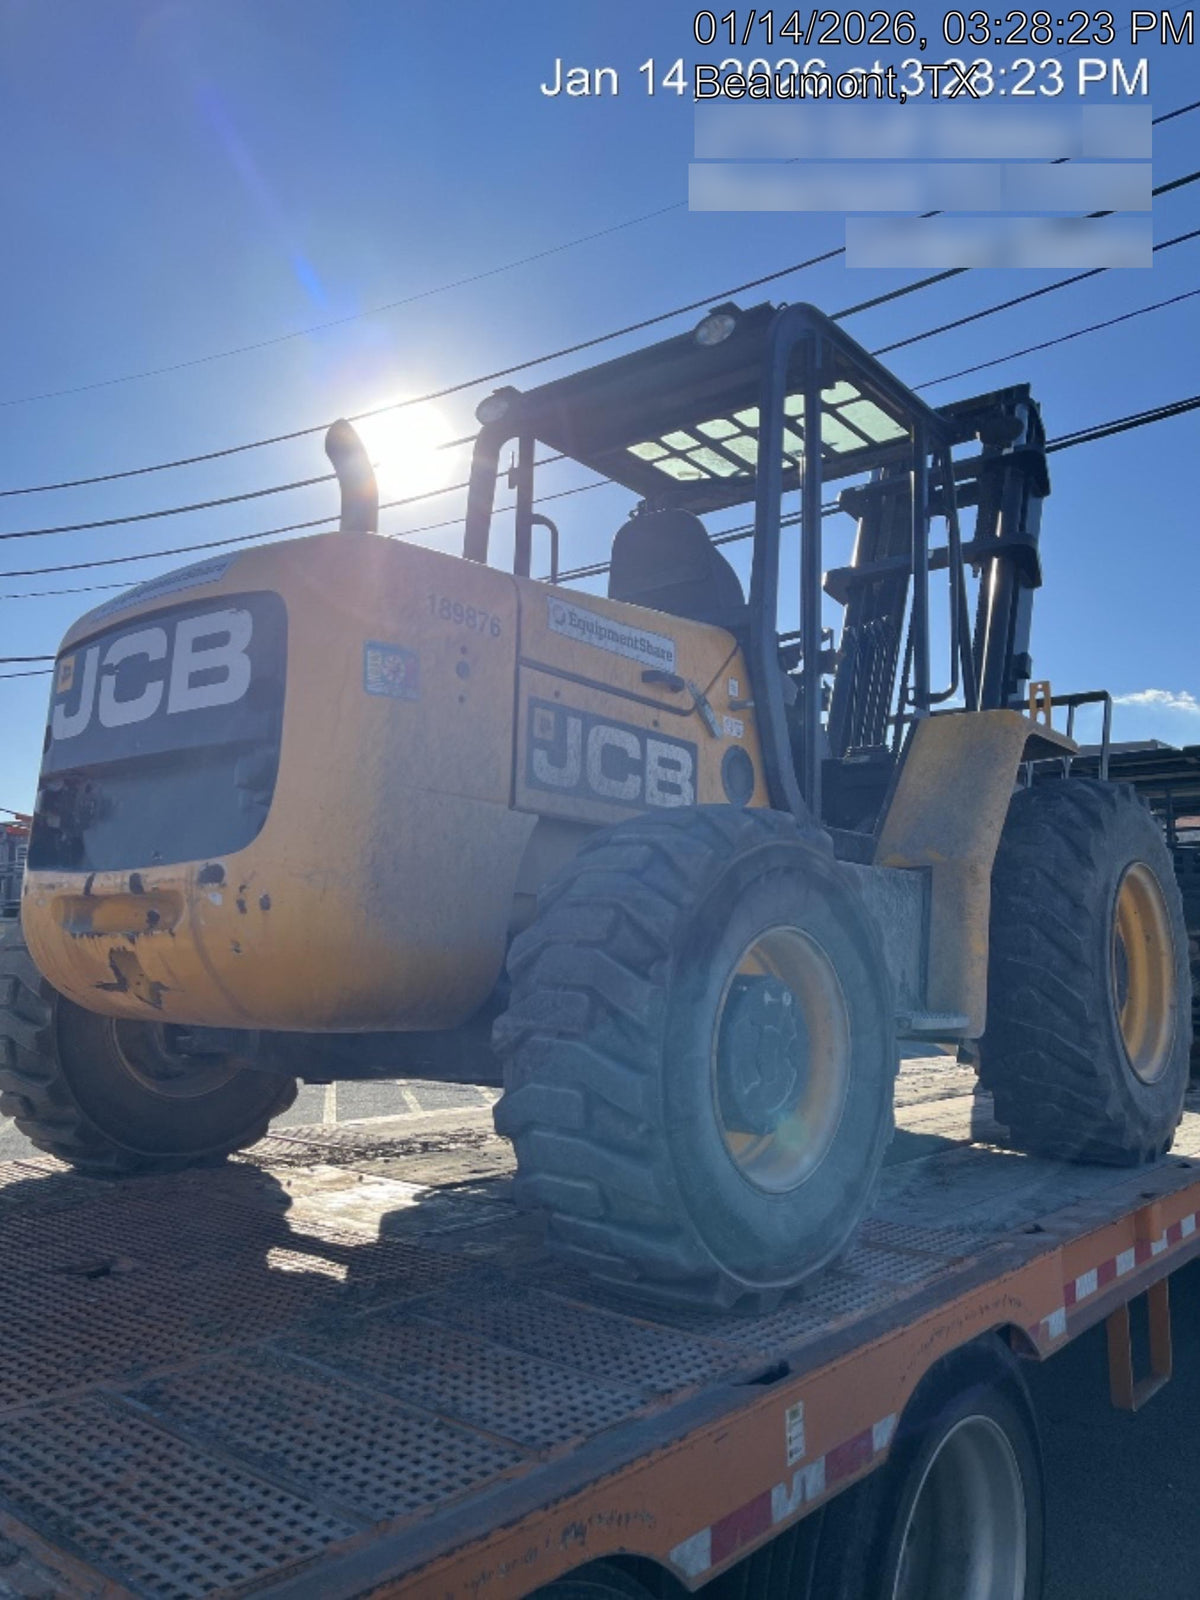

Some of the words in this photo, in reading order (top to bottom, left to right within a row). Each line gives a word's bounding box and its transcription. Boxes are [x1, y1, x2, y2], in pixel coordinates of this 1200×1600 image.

[426, 594, 502, 638] 189876
[567, 610, 674, 663] EquipmentShare
[51, 607, 253, 740] JCB
[532, 717, 696, 808] JCB
